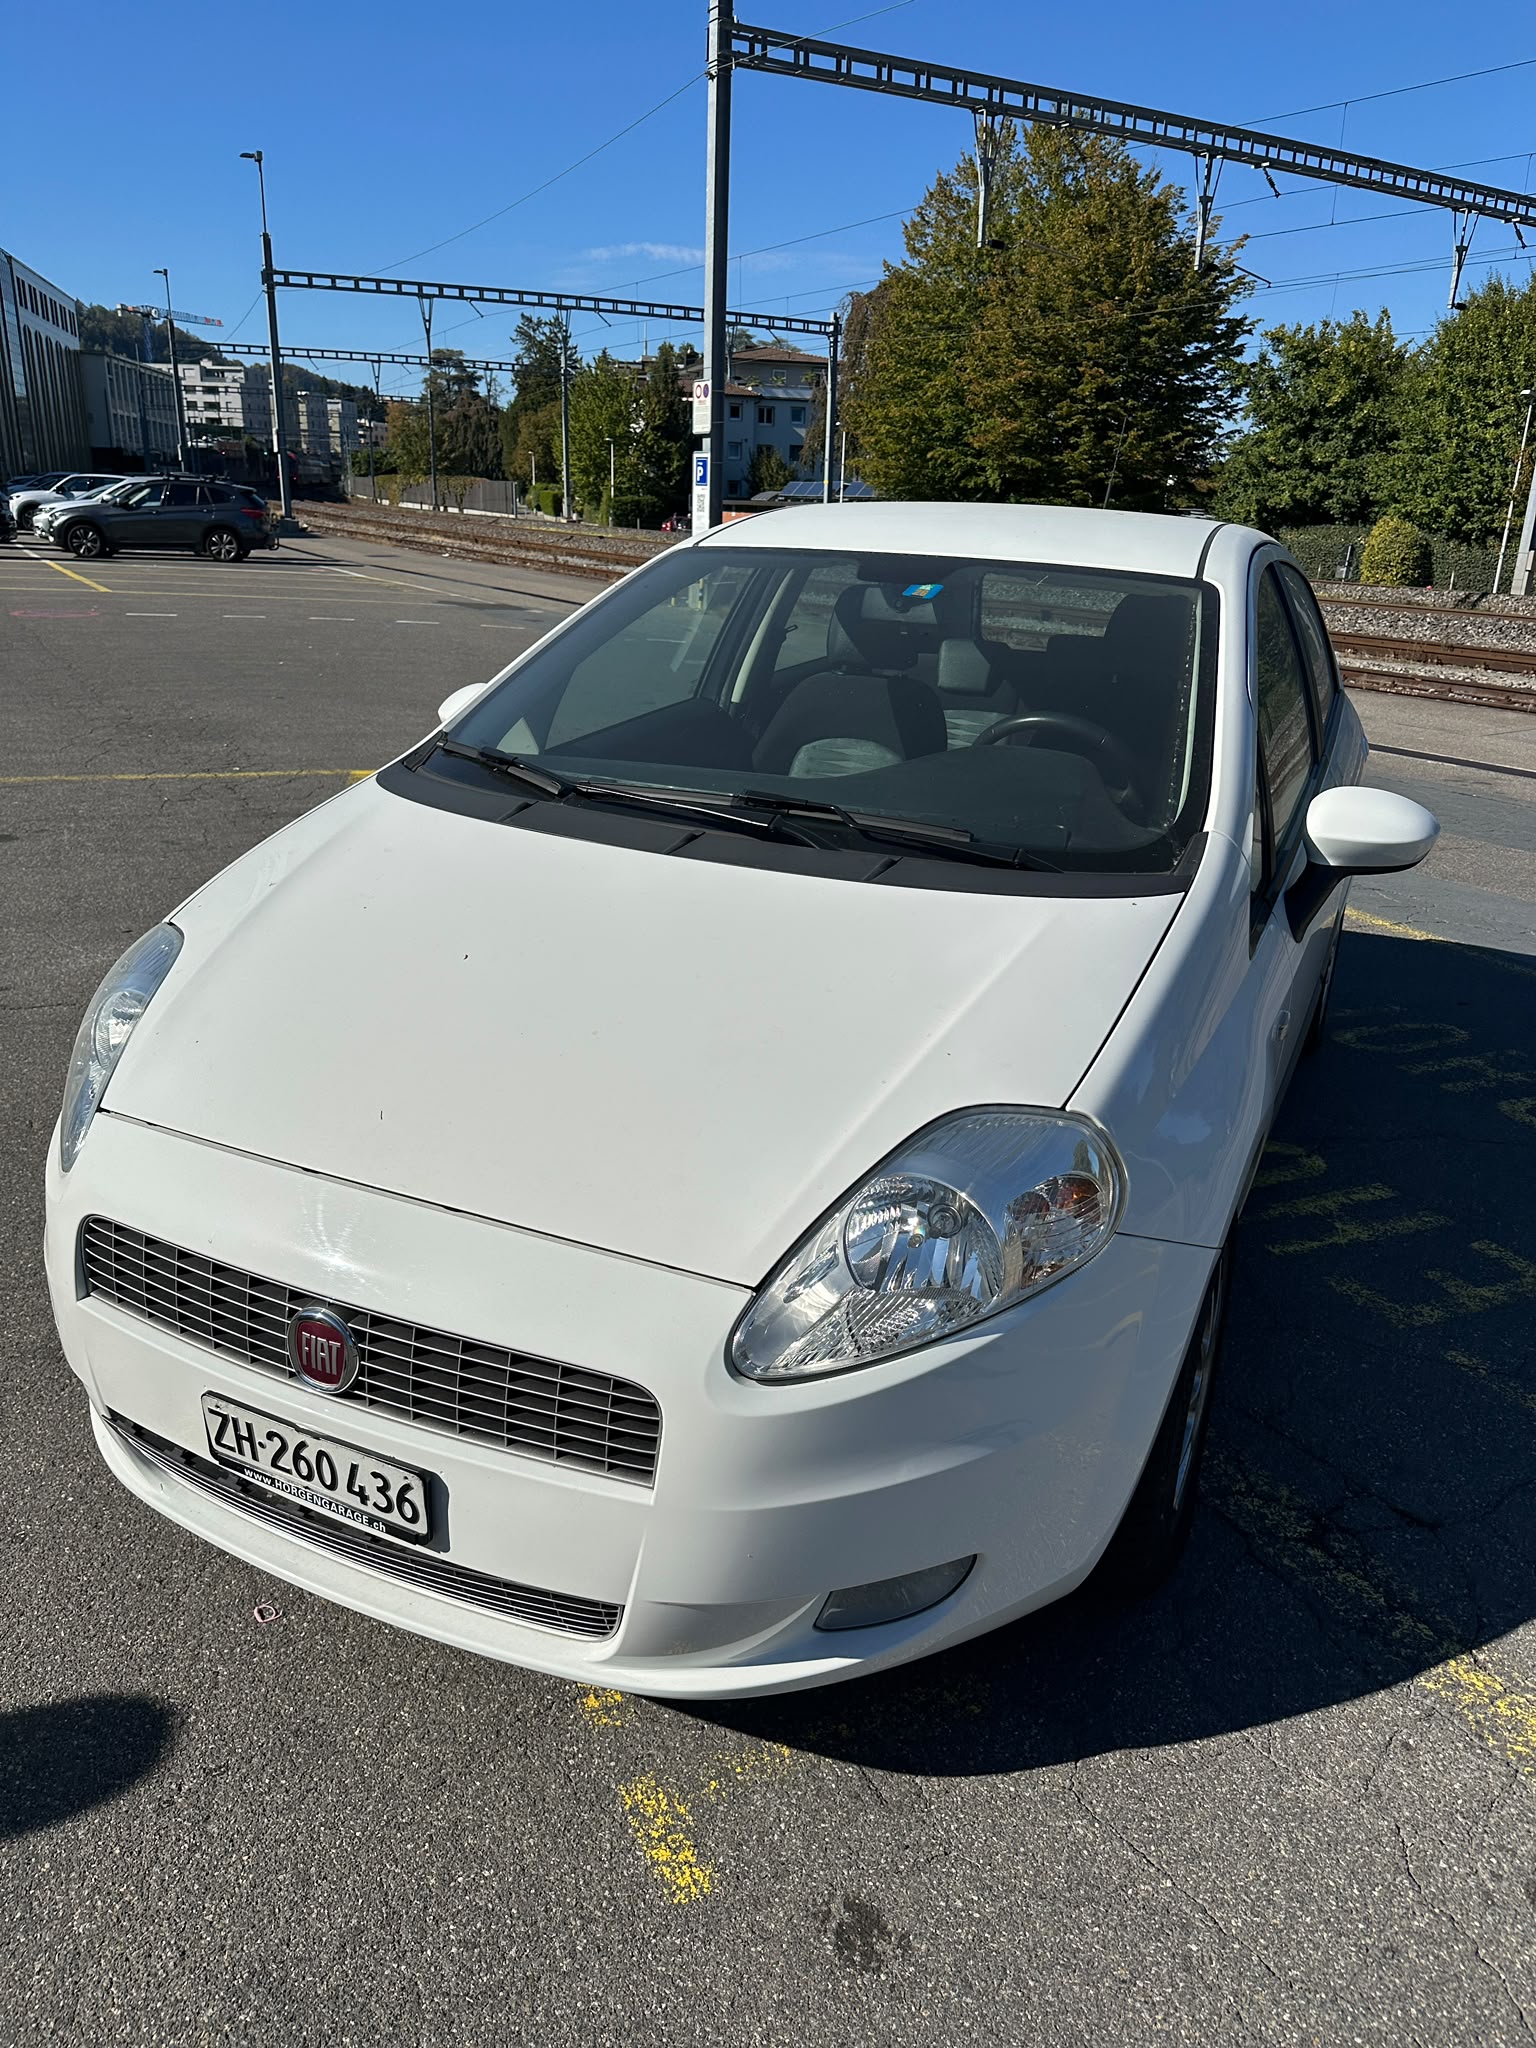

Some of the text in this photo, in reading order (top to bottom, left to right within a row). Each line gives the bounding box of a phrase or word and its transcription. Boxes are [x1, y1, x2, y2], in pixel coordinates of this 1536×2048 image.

[696, 465, 704, 481] P
[301, 1331, 341, 1376] FIAT
[243, 1467, 387, 1534] www.HORGENGARAGE.ch
[346, 1461, 420, 1525] 436
